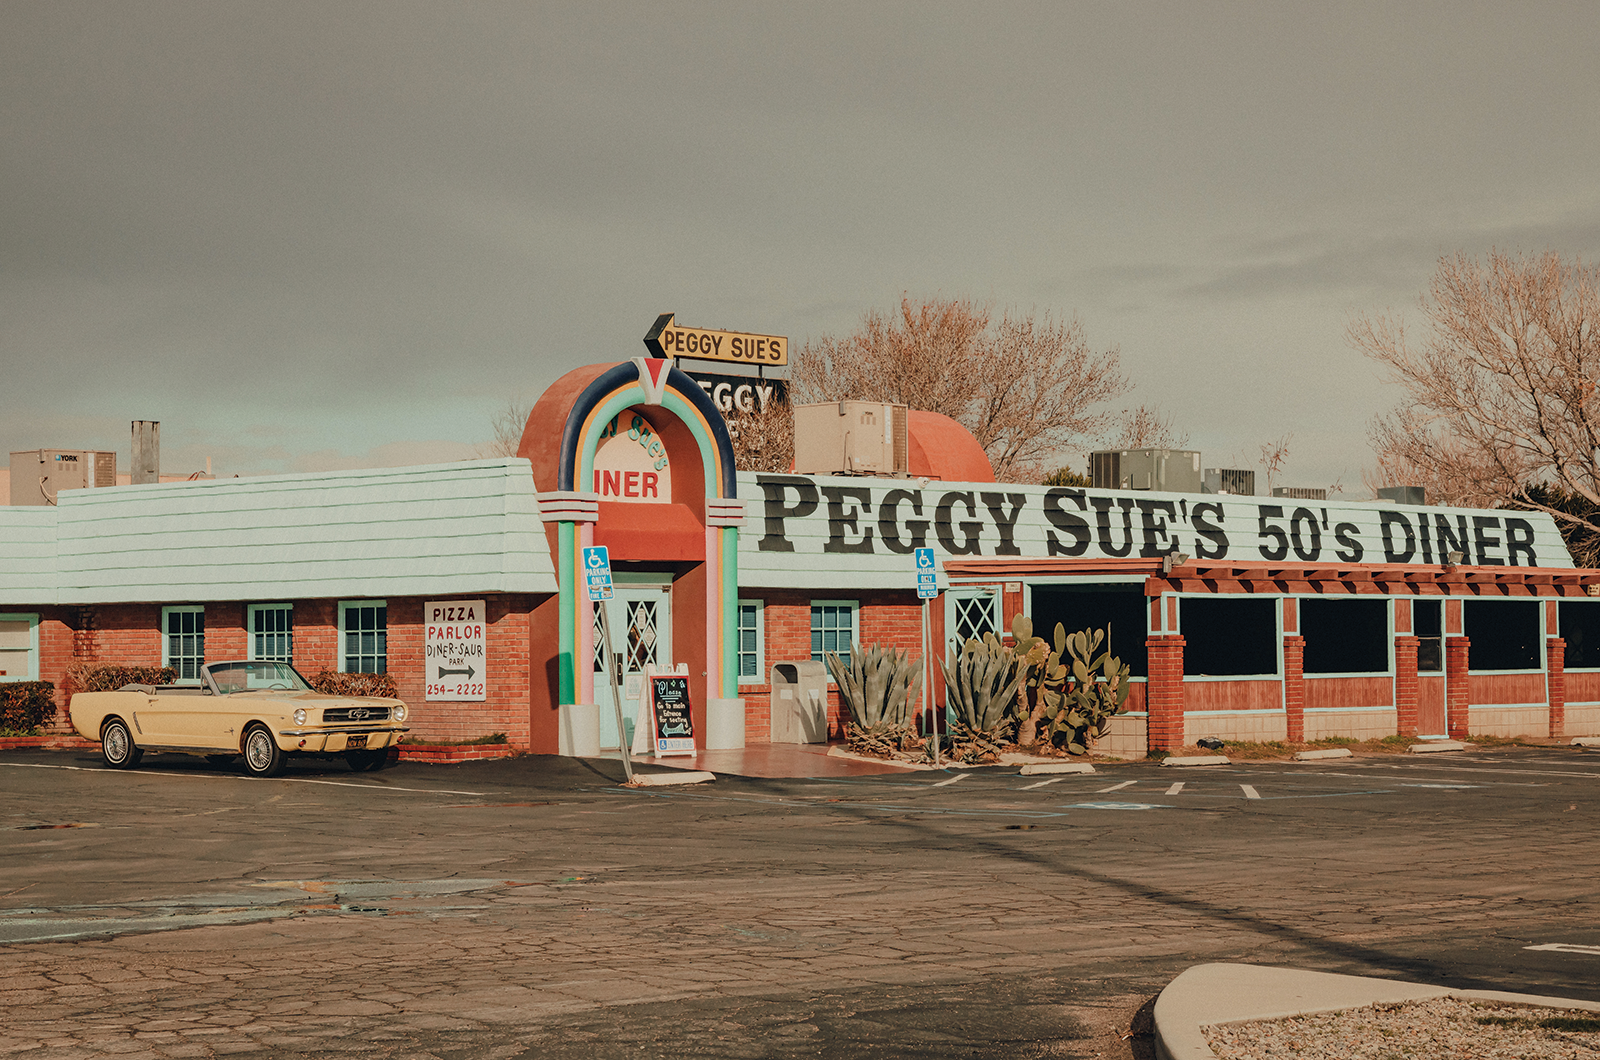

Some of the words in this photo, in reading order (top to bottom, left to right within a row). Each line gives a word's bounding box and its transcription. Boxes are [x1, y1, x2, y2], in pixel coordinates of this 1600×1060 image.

[664, 330, 723, 355] PEGGY
[731, 337, 781, 360] SUE'S
[627, 415, 668, 471] Sue's
[60, 454, 78, 462] YORK
[594, 469, 658, 498] INER
[756, 474, 1027, 556] PEGGY
[1043, 487, 1229, 560] SUE'S
[1258, 504, 1364, 562] 50's
[1379, 510, 1538, 567] DINER
[586, 567, 610, 576] PARKING
[591, 576, 606, 584] ONLY
[921, 575, 932, 583] ONLY
[433, 607, 475, 621] PIZZA
[428, 625, 482, 639] PARLOR
[426, 643, 483, 658] DINER-SAUR
[427, 683, 483, 695] 254-2222
[658, 681, 682, 695] Please
[668, 740, 681, 749] ENTER
[682, 740, 693, 748] HERE
